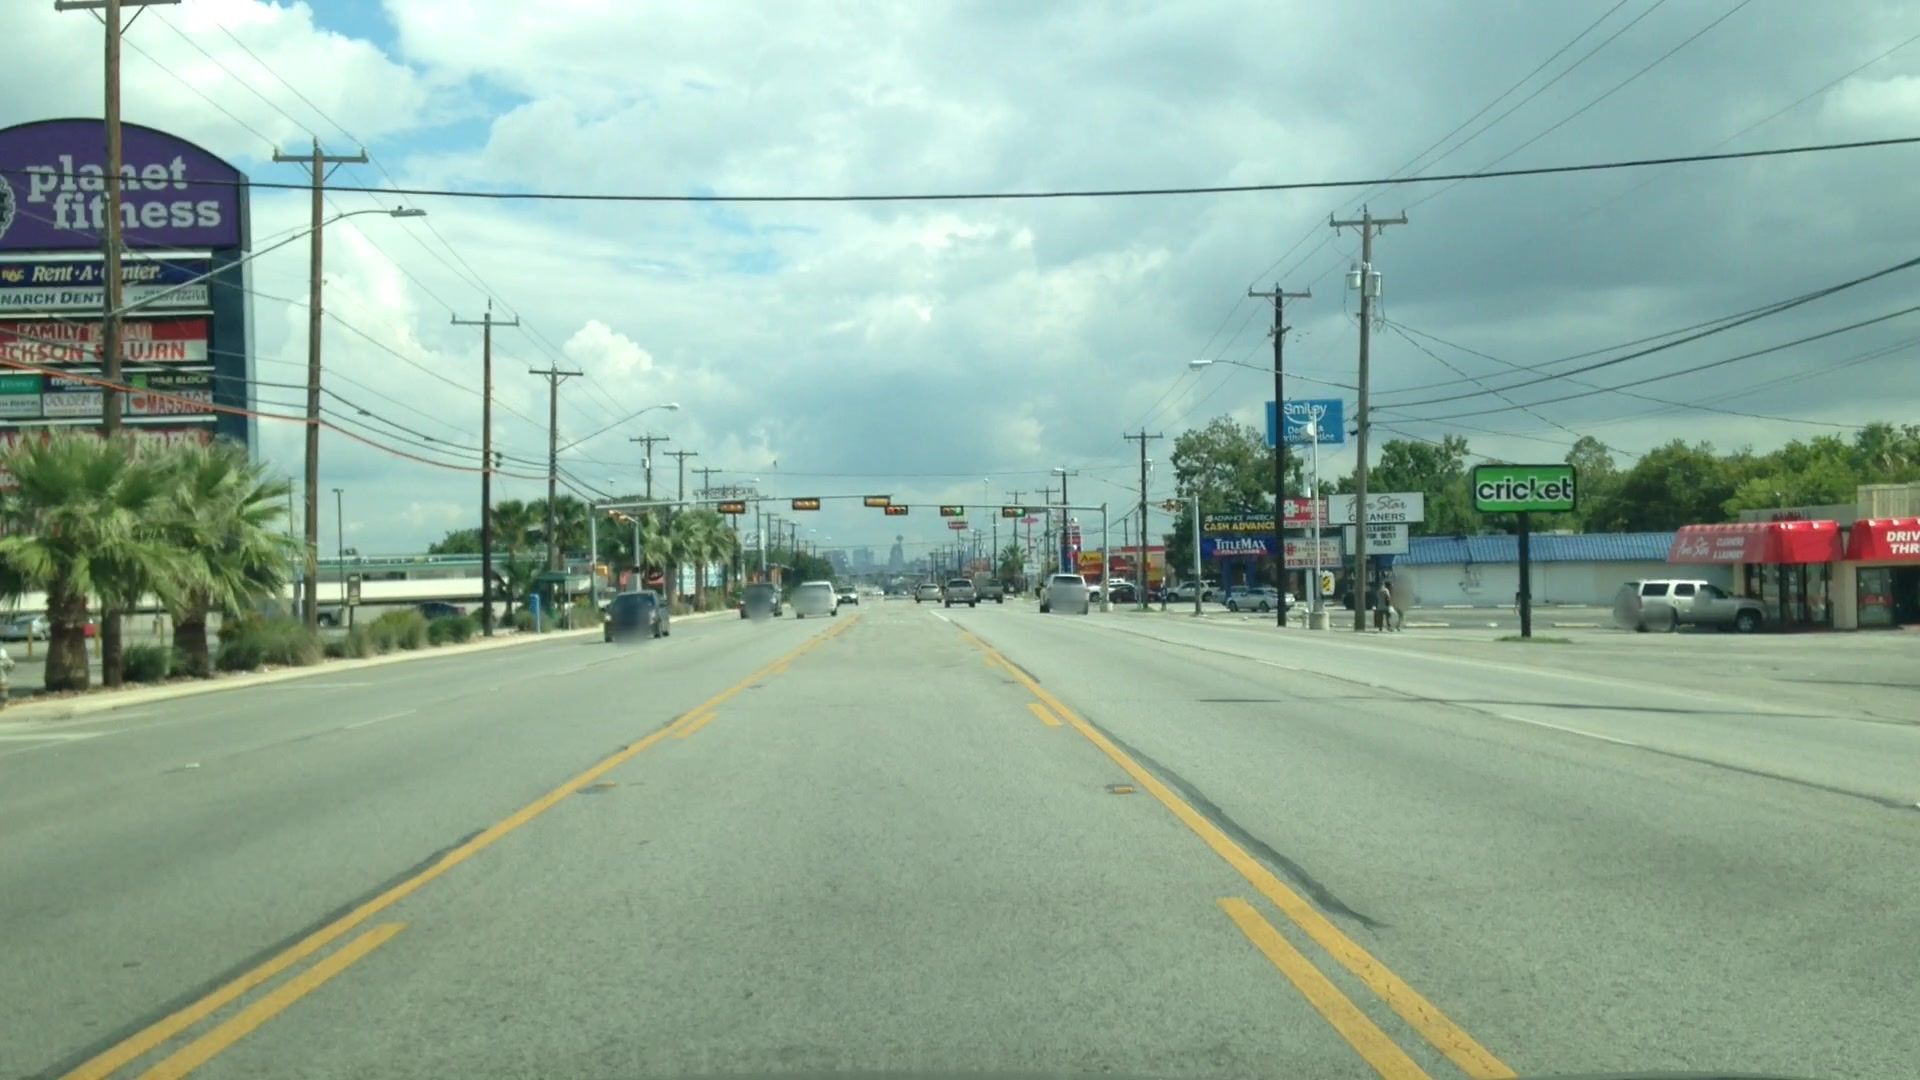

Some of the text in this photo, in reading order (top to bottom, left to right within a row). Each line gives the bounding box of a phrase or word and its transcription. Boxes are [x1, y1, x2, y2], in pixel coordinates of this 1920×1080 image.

[26, 155, 188, 203] planet
[53, 192, 222, 230] fitness
[18, 323, 80, 340] FAMILY
[1478, 476, 1573, 502] cricket
[1376, 495, 1408, 511] Star
[1204, 522, 1230, 531] CASH
